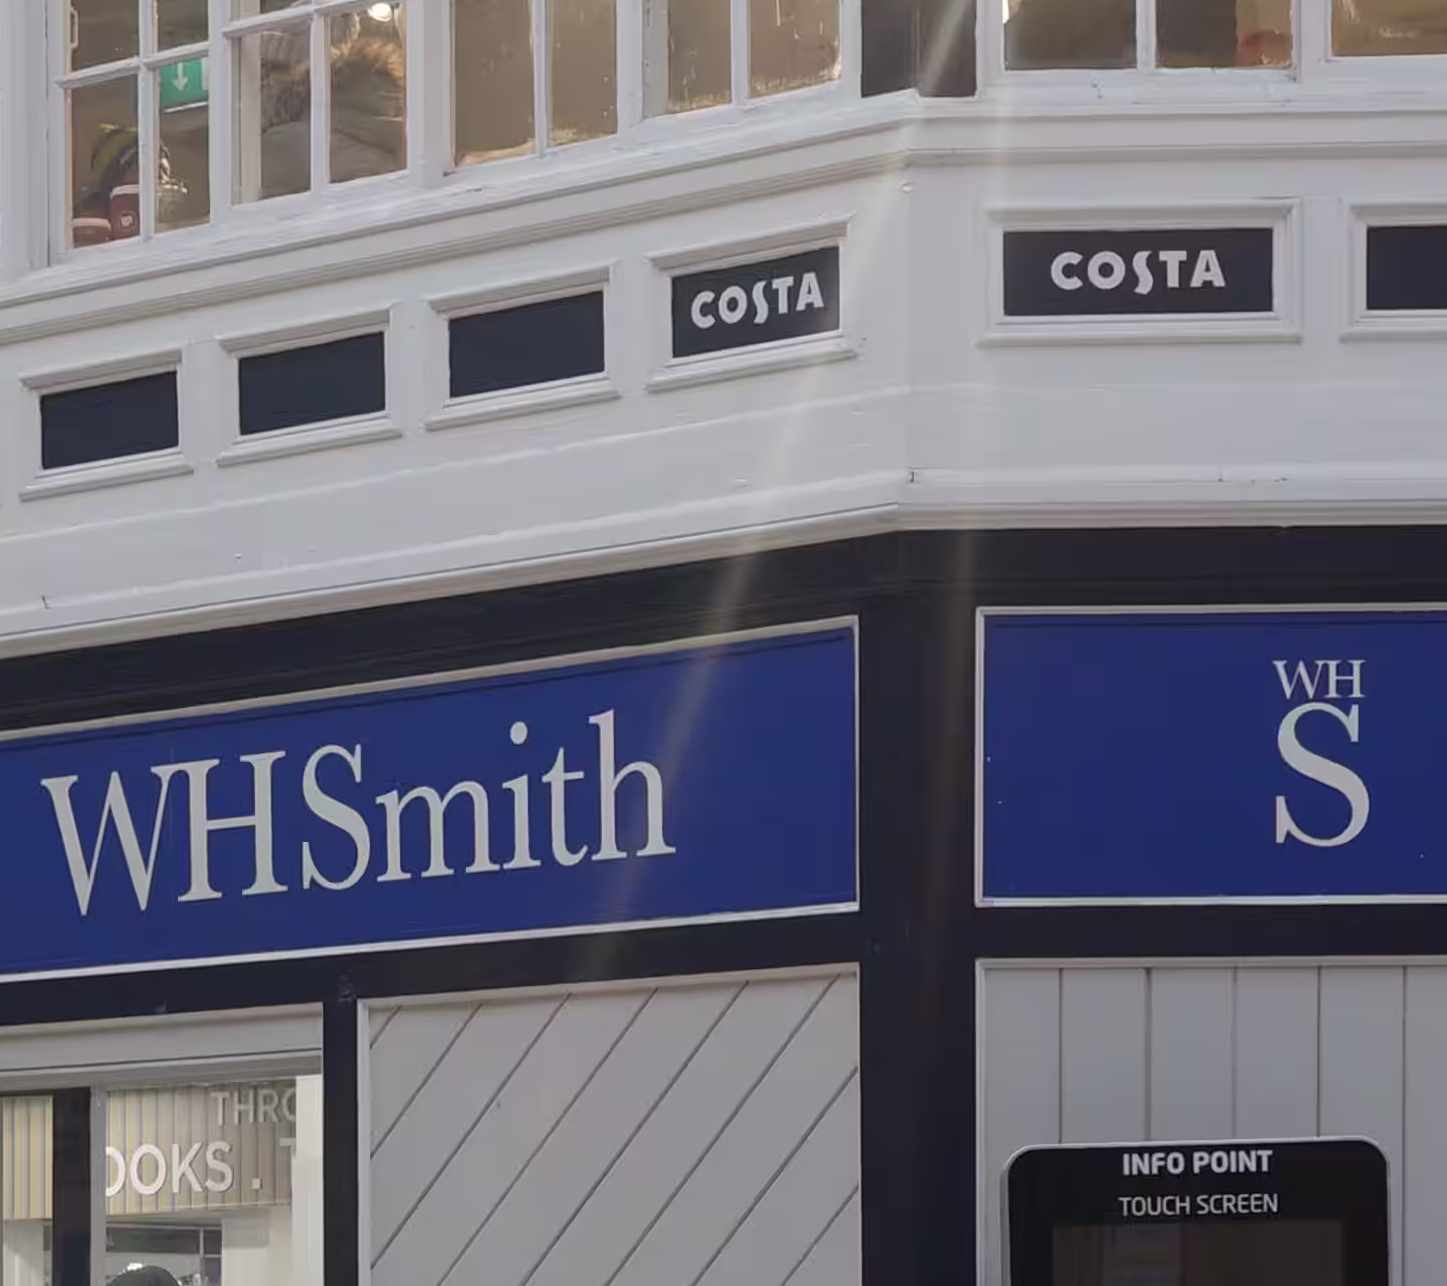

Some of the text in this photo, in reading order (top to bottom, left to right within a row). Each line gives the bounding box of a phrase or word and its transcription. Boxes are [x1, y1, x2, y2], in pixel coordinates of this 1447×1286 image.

[1050, 249, 1226, 295] COSTA
[690, 271, 826, 329] COSTA
[1271, 659, 1366, 700] WH
[1273, 701, 1371, 848] S
[40, 708, 677, 916] WHSmith
[1122, 1149, 1274, 1176] INFO POINT
[1118, 1193, 1279, 1217] TOUCH SCREEN
